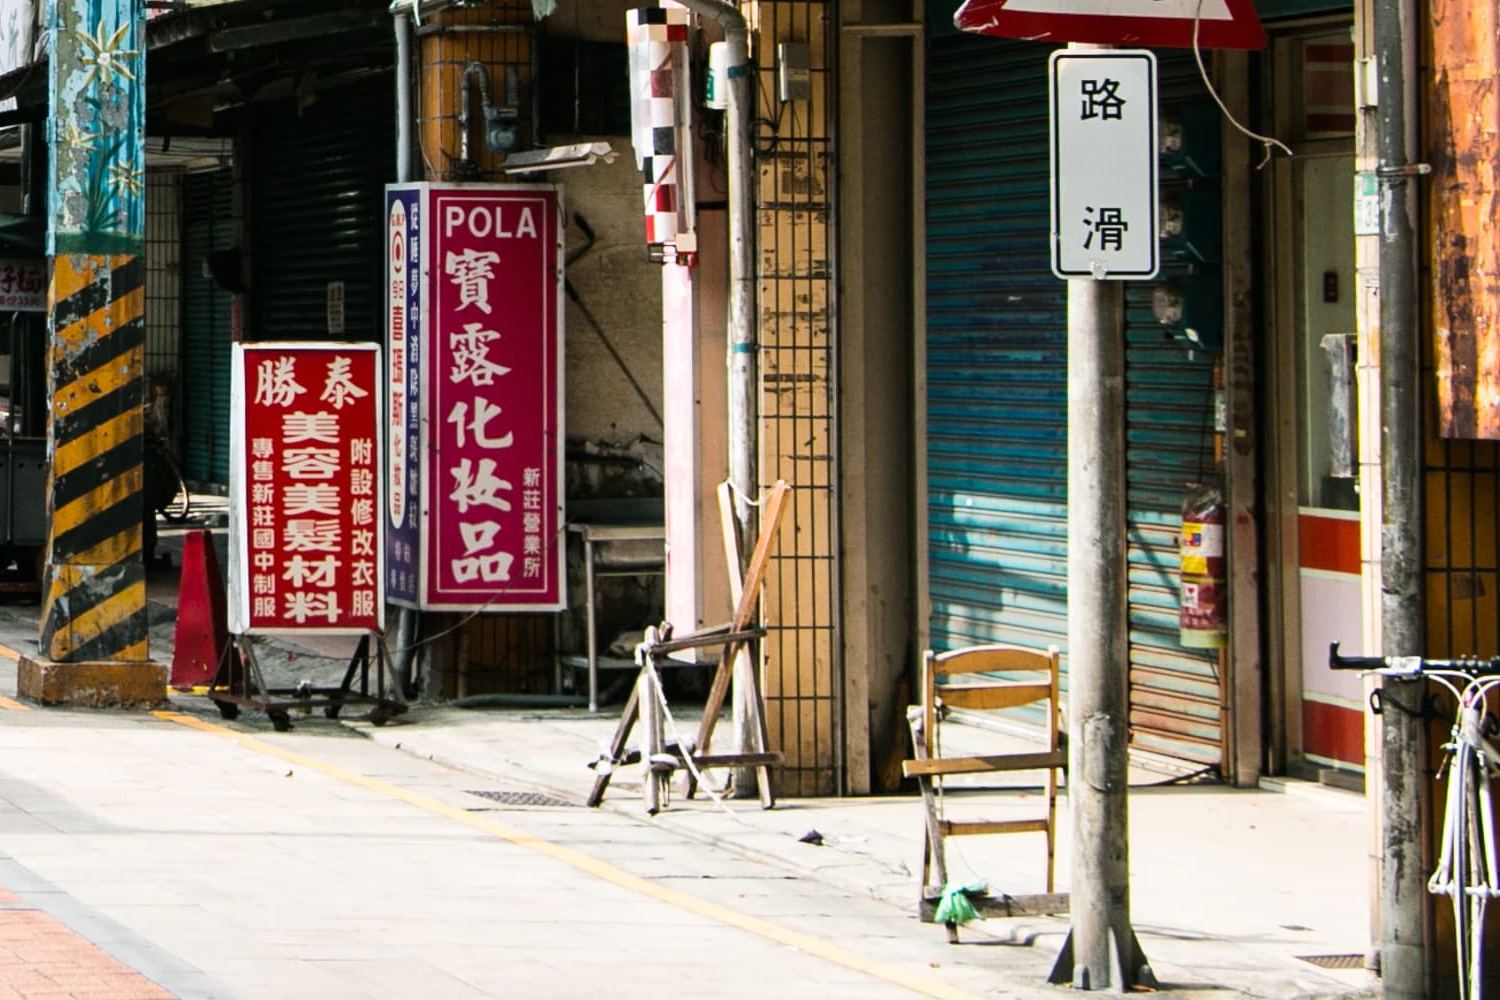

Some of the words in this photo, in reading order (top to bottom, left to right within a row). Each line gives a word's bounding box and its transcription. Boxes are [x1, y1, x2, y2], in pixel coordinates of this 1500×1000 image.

[444, 204, 538, 240] POLA
[1079, 77, 1130, 252] 路滑
[253, 354, 370, 411] 勝泰
[251, 436, 277, 620] 專售新莊國中制服
[280, 410, 344, 625] 美容美髮材料
[349, 437, 376, 618] 附設修改衣服
[522, 467, 541, 578] 新莊營業所
